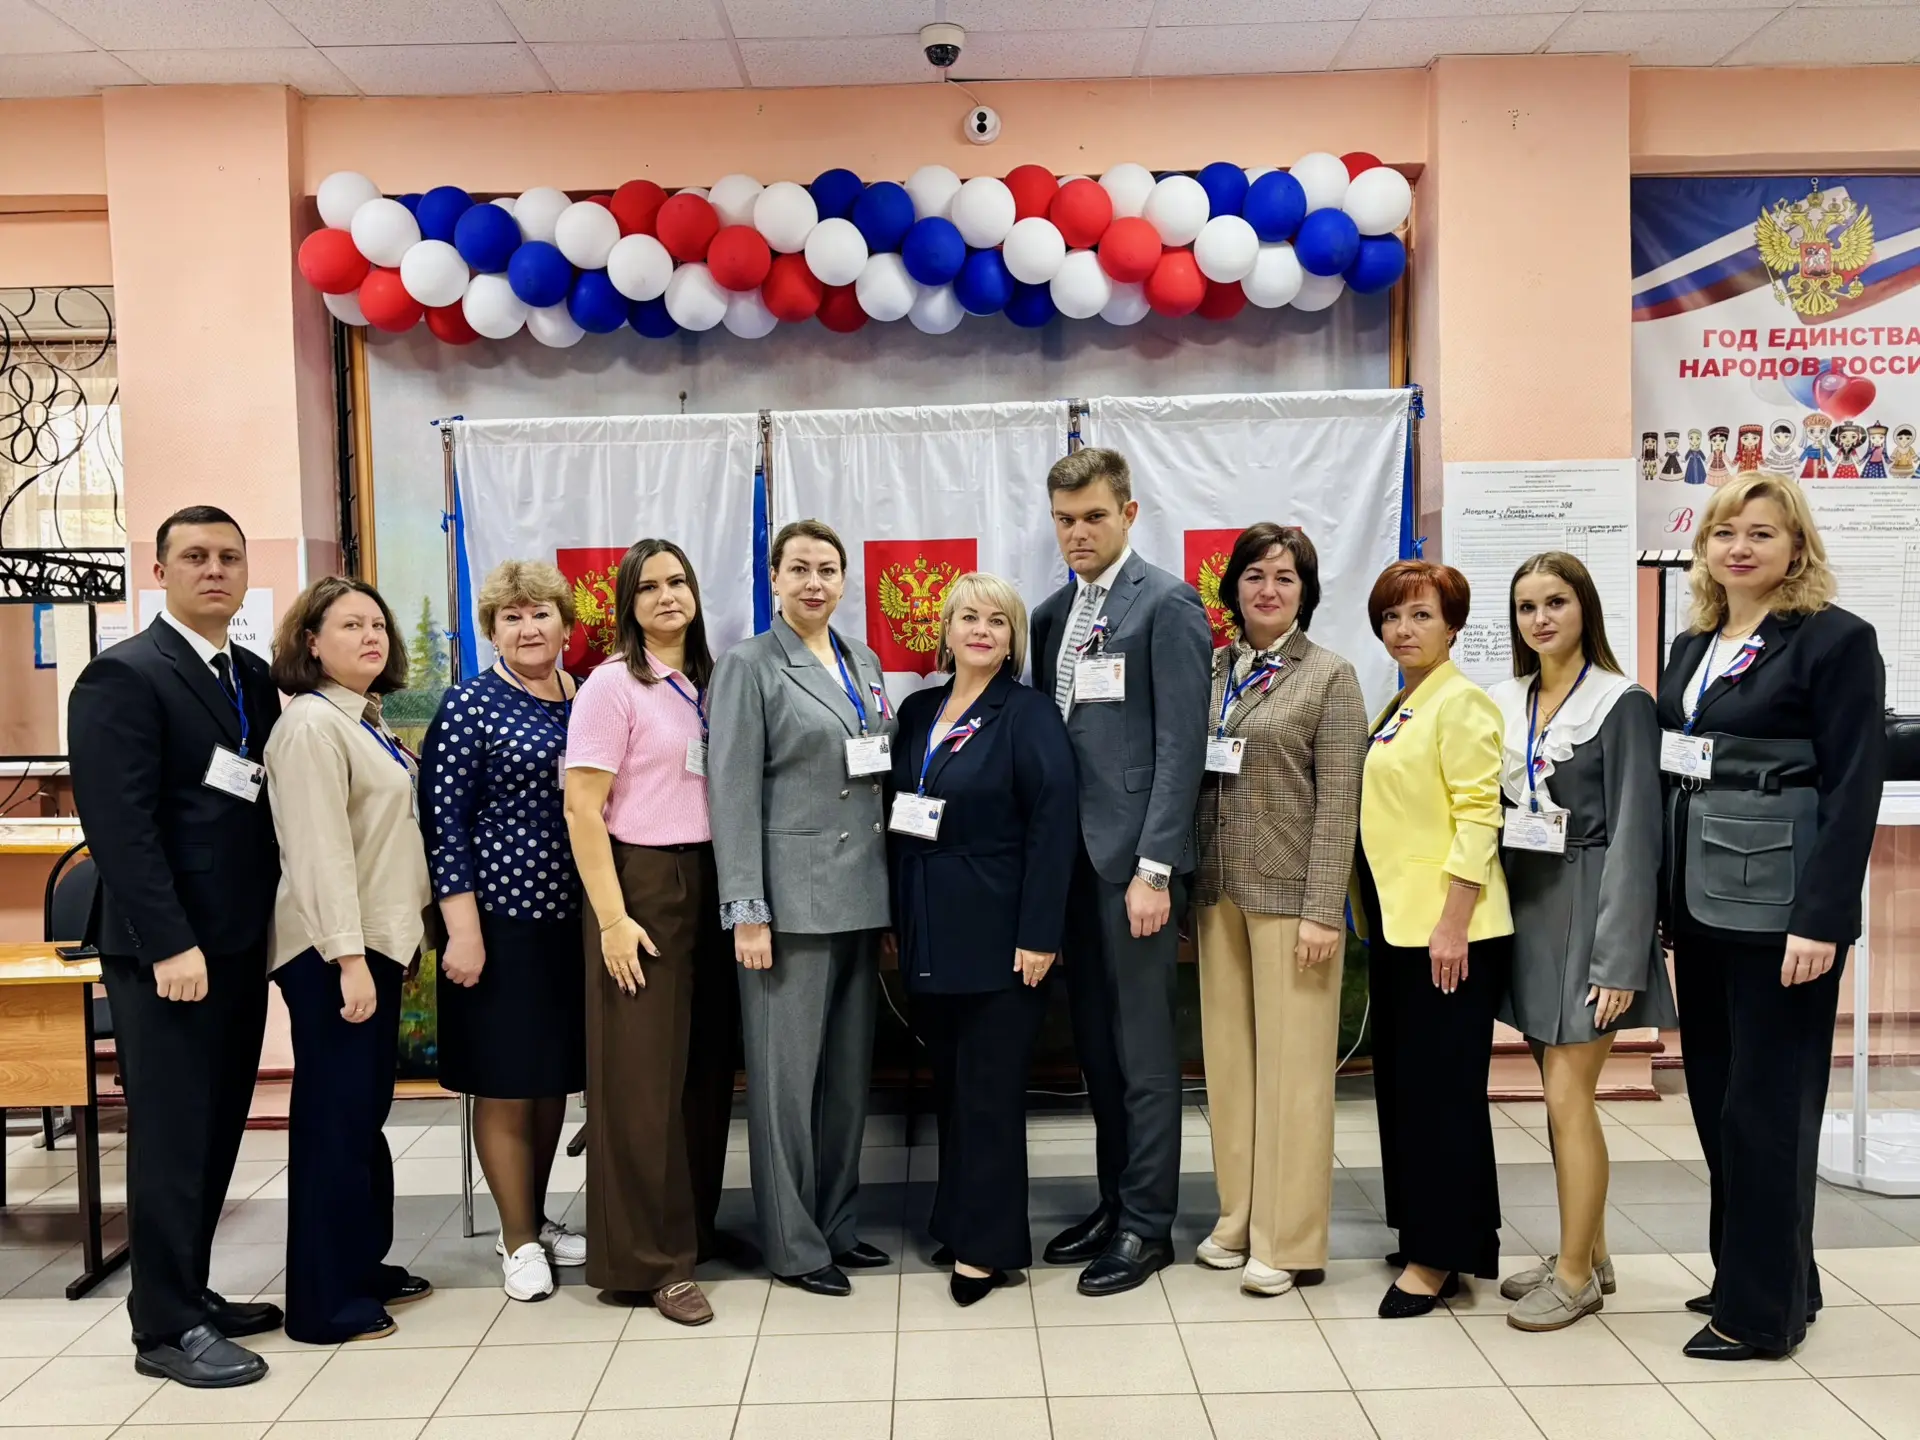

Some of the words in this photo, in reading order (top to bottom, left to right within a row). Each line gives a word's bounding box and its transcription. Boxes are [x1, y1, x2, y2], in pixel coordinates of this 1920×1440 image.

[1703, 329, 1758, 352] ГОД
[1768, 327, 1920, 351] ЕДИНСТВА
[1679, 357, 1821, 380] НАРОДОВ
